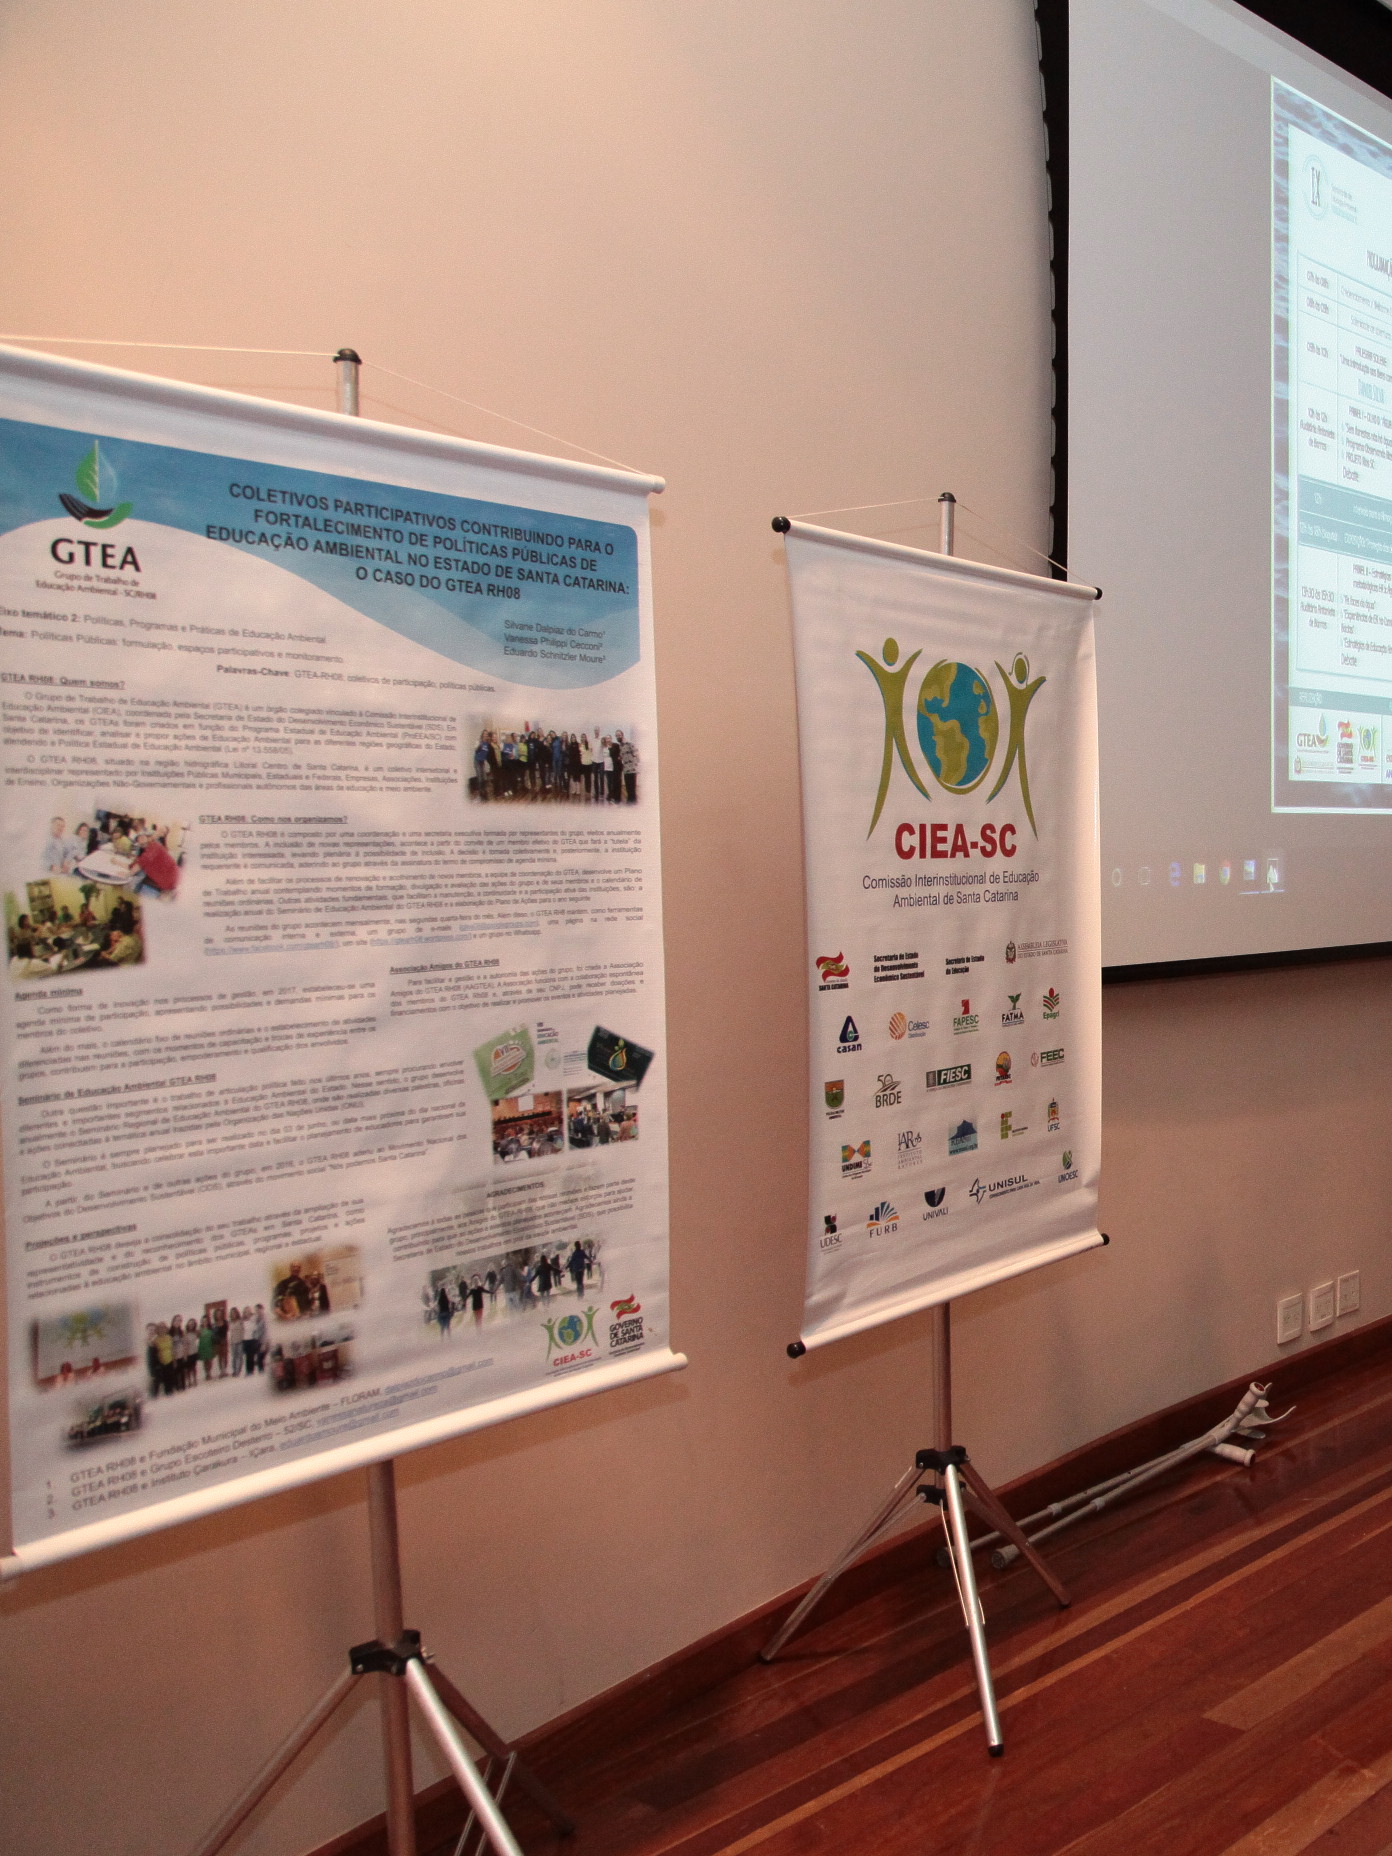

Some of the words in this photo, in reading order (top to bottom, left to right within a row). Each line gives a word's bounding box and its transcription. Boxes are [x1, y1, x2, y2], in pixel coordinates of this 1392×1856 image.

[229, 483, 330, 512] COLETIVOS
[333, 498, 457, 532] PARTICIPATIVOS
[460, 519, 565, 548] CONTRIBUINDO
[567, 535, 602, 554] PARA
[603, 542, 615, 556] O
[253, 508, 404, 544] FORTALECIMENTO
[408, 531, 429, 548] DE
[432, 534, 508, 560] POLÍTICAS
[511, 545, 577, 568] PÚBLICAS
[580, 557, 598, 573] DE
[50, 537, 142, 573] GTEA
[206, 524, 309, 553] EDUCAÇÃO
[313, 538, 404, 565] AMBIENTAL
[407, 552, 429, 568] NO
[433, 555, 491, 577] ESTADO
[494, 564, 514, 579] DE
[516, 566, 561, 586] SANTA
[563, 572, 631, 596] CATARINA:
[83, 573, 93, 582] de
[130, 578, 140, 588] de
[355, 566, 369, 581] O
[372, 568, 415, 587] CASO
[419, 574, 442, 590] DO
[445, 577, 483, 596] GTEA
[486, 583, 521, 600] RH08
[21, 609, 69, 622] temático
[129, 618, 178, 633] Programas
[504, 619, 534, 632] Silvane
[535, 622, 565, 636] Dalpiaz
[566, 626, 577, 636] do
[503, 633, 538, 645] Vanessa
[540, 636, 568, 649] Philippi
[503, 645, 538, 658] Eduardo
[1297, 733, 1317, 748] GTEA
[894, 822, 1018, 860] CIEA-SC
[862, 875, 913, 890] Comissão
[914, 871, 987, 887] Interinstitucional
[988, 871, 1001, 884] de
[1002, 869, 1040, 886] Educação
[892, 893, 941, 908] Ambiental
[942, 893, 954, 905] de
[956, 890, 981, 905] Santa
[983, 889, 1019, 903] Catarina
[880, 962, 919, 973] Desenvolvimento
[873, 974, 900, 983] Econômico
[953, 1014, 979, 1027] FAPESC
[1001, 1011, 1024, 1023] FATMA
[1042, 1011, 1060, 1020] Epagri
[908, 1020, 930, 1032] Celesc
[836, 1042, 862, 1054] casan
[1040, 1048, 1065, 1063] FEEC
[940, 1066, 969, 1084] FIESC
[875, 1091, 902, 1109] BRDE
[1047, 1122, 1060, 1132] UFSC
[841, 1160, 863, 1173] UNDIME
[988, 1174, 1028, 1192] UNISUL
[1058, 1169, 1079, 1184] UNOESC
[922, 1206, 949, 1222] UNIVALI
[869, 1223, 898, 1238] FURB
[820, 1233, 842, 1249] UDESC
[609, 1316, 644, 1333] GOVERNO
[609, 1330, 619, 1340] DE
[620, 1325, 643, 1338] SANTA
[609, 1332, 644, 1348] CATARINA
[553, 1348, 593, 1367] CIEA-SC
